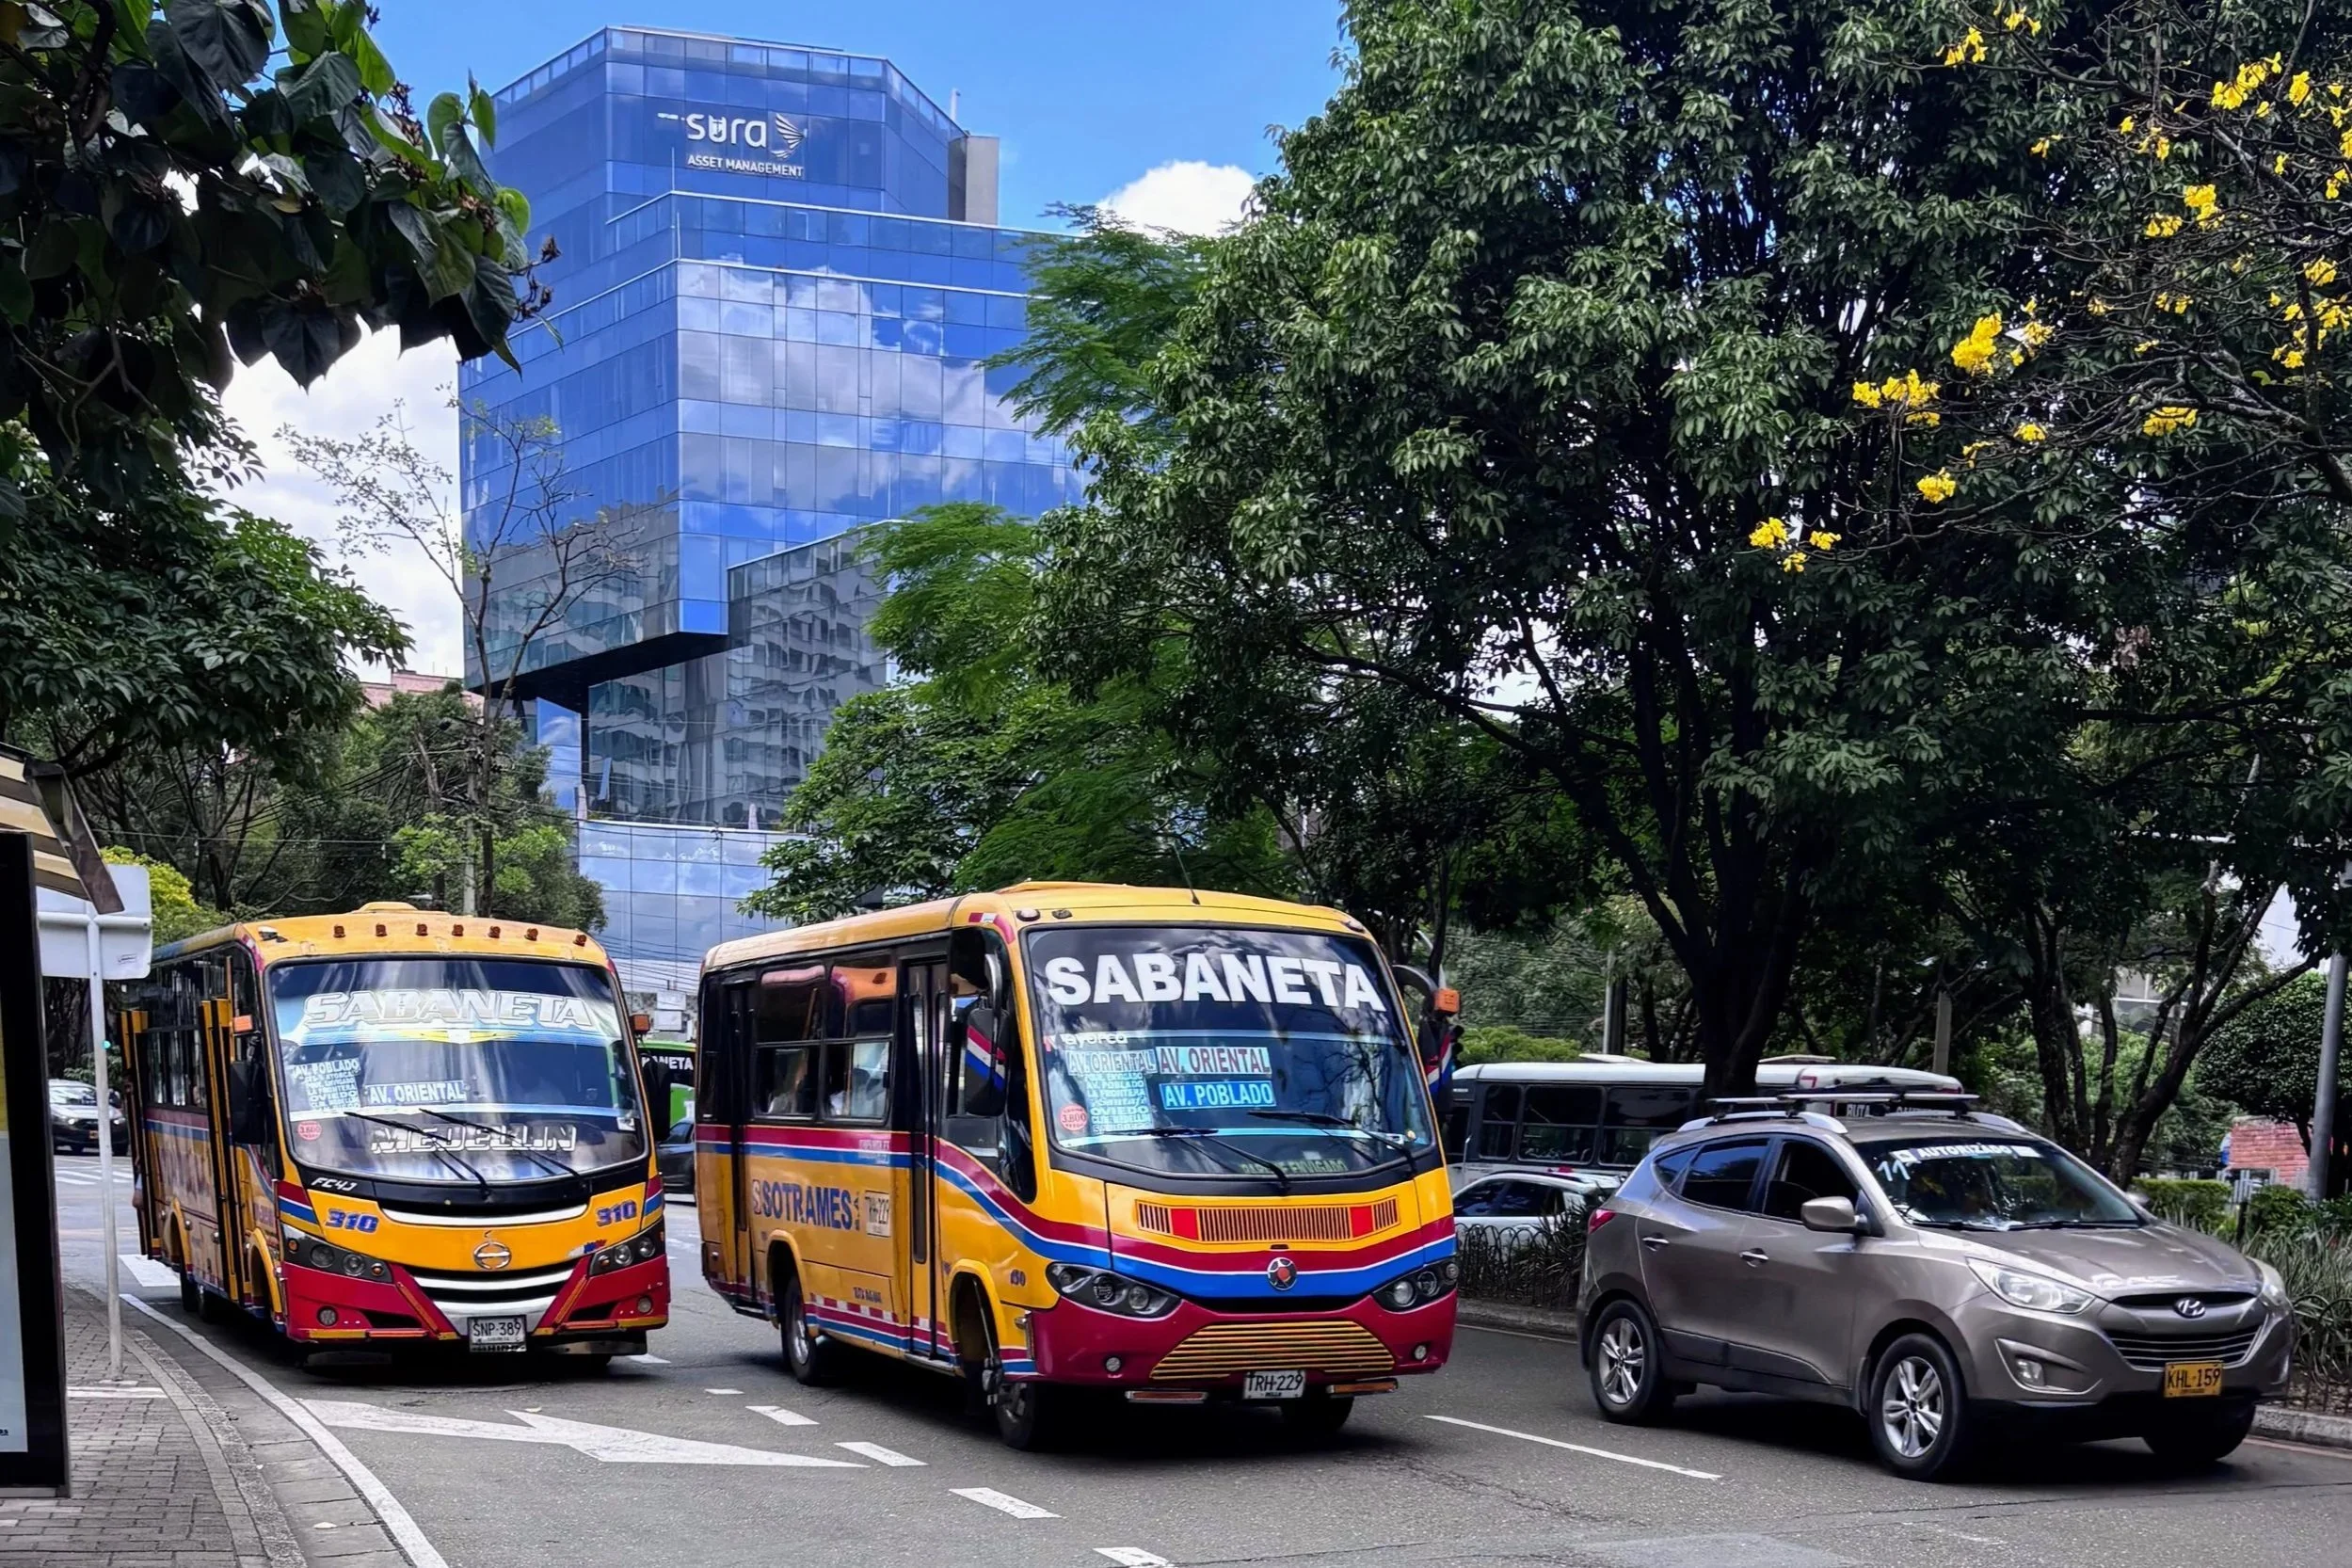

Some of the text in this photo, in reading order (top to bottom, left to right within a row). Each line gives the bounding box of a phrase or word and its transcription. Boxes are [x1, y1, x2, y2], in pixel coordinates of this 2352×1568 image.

[686, 113, 768, 148] sura
[687, 154, 804, 177] ASSET MANAGEMENT
[1044, 952, 1386, 1013] SABANETA
[304, 988, 596, 1029] SABANETA
[1092, 1049, 1156, 1072] ORIENTAL
[1160, 1047, 1271, 1074] AV. ORIENTAL
[309, 1090, 358, 1102] OVIEDO
[369, 1085, 392, 1105] AV.
[393, 1081, 466, 1102] ORIENTAL
[1164, 1082, 1273, 1106] AV. POBLADO
[1090, 1105, 1149, 1116] OVIEDO
[1846, 1103, 1871, 1117] RUTA
[1917, 1143, 2012, 1160] AUTORIZADO
[311, 1176, 358, 1192] FC4J
[597, 1199, 638, 1227] 310
[761, 1179, 853, 1231] SOTRAMES
[326, 1208, 379, 1234] 310
[472, 1321, 522, 1337] SNP-389
[1248, 1373, 1304, 1392] TRH-229
[2168, 1368, 2221, 1389] KHL-159
